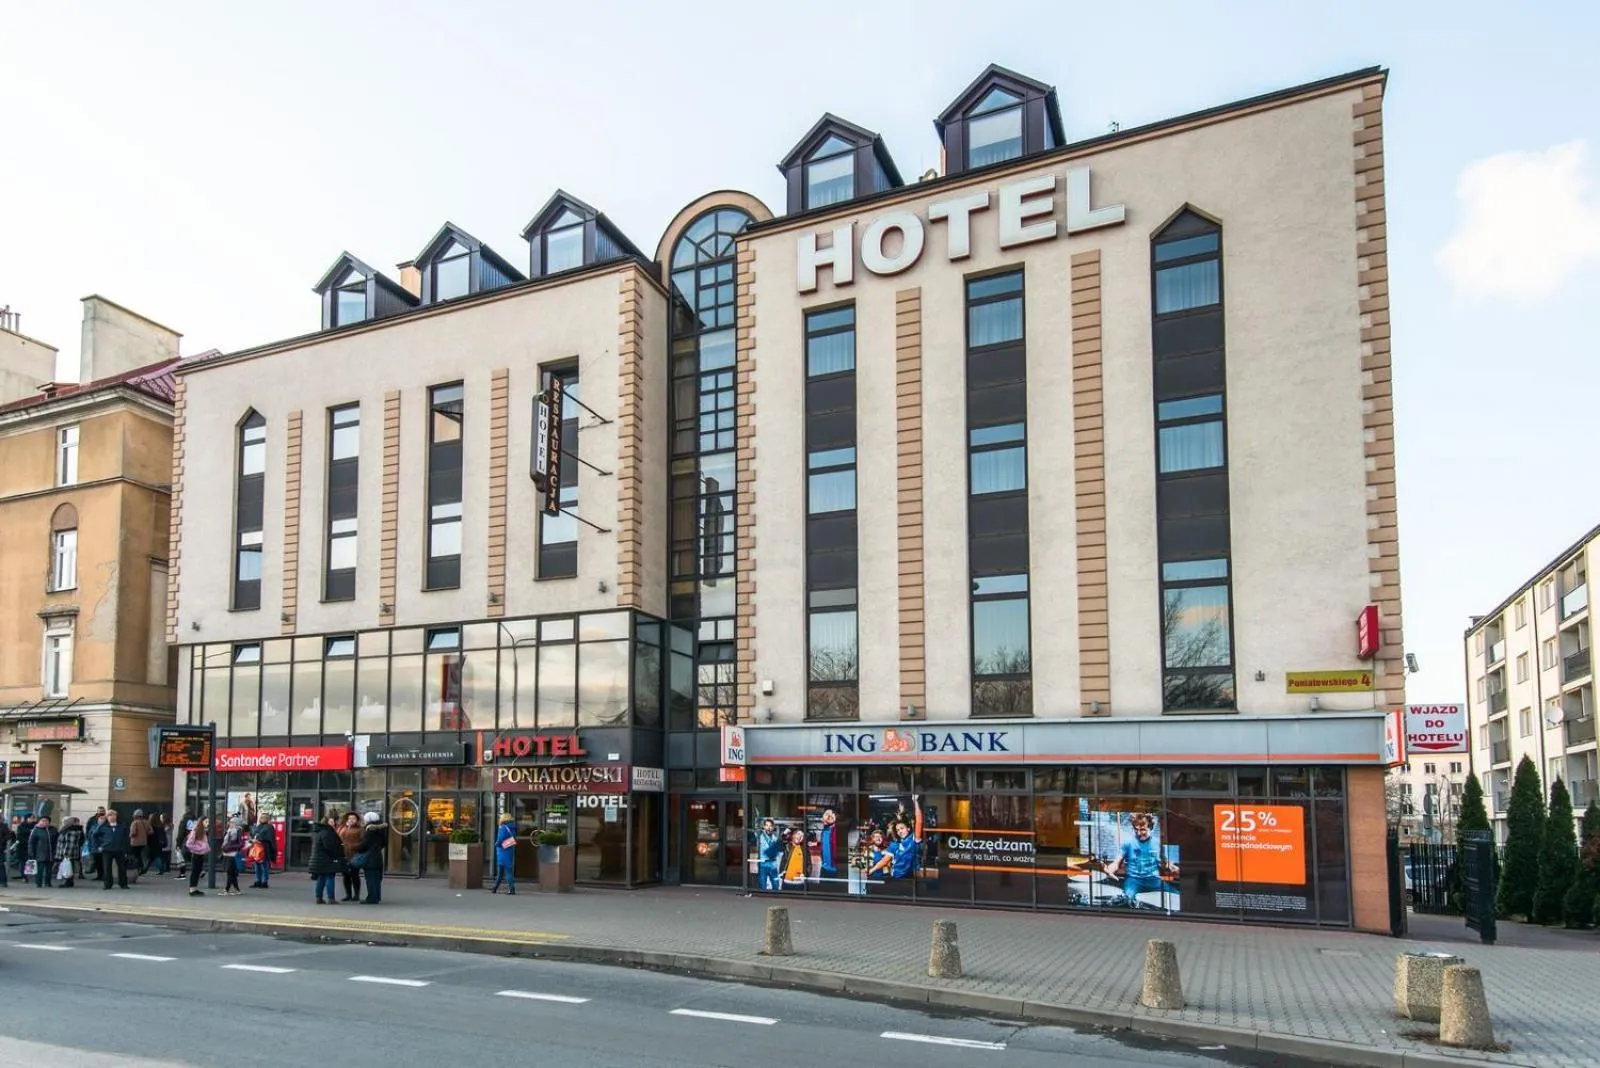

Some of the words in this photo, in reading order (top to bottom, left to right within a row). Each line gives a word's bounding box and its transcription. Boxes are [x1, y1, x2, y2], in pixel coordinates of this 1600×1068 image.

[797, 165, 1126, 294] HOTEL
[539, 406, 547, 472] HOTEL
[549, 379, 560, 511] RESTAURACJA
[1362, 673, 1370, 686] 4
[1410, 706, 1458, 714] WJAZD
[1425, 720, 1444, 728] DO
[824, 734, 876, 752] ING
[920, 732, 1009, 751] BANK
[1408, 734, 1463, 742] HOTELU
[495, 735, 587, 757] HOTEL
[221, 755, 277, 767] Santander
[279, 753, 320, 767] Partner
[728, 748, 743, 761] ING
[498, 767, 623, 783] PONIATOWSKI
[637, 769, 660, 778] HOTEL
[577, 796, 628, 808] HOTEL
[948, 836, 1036, 854] Oszczędzam,
